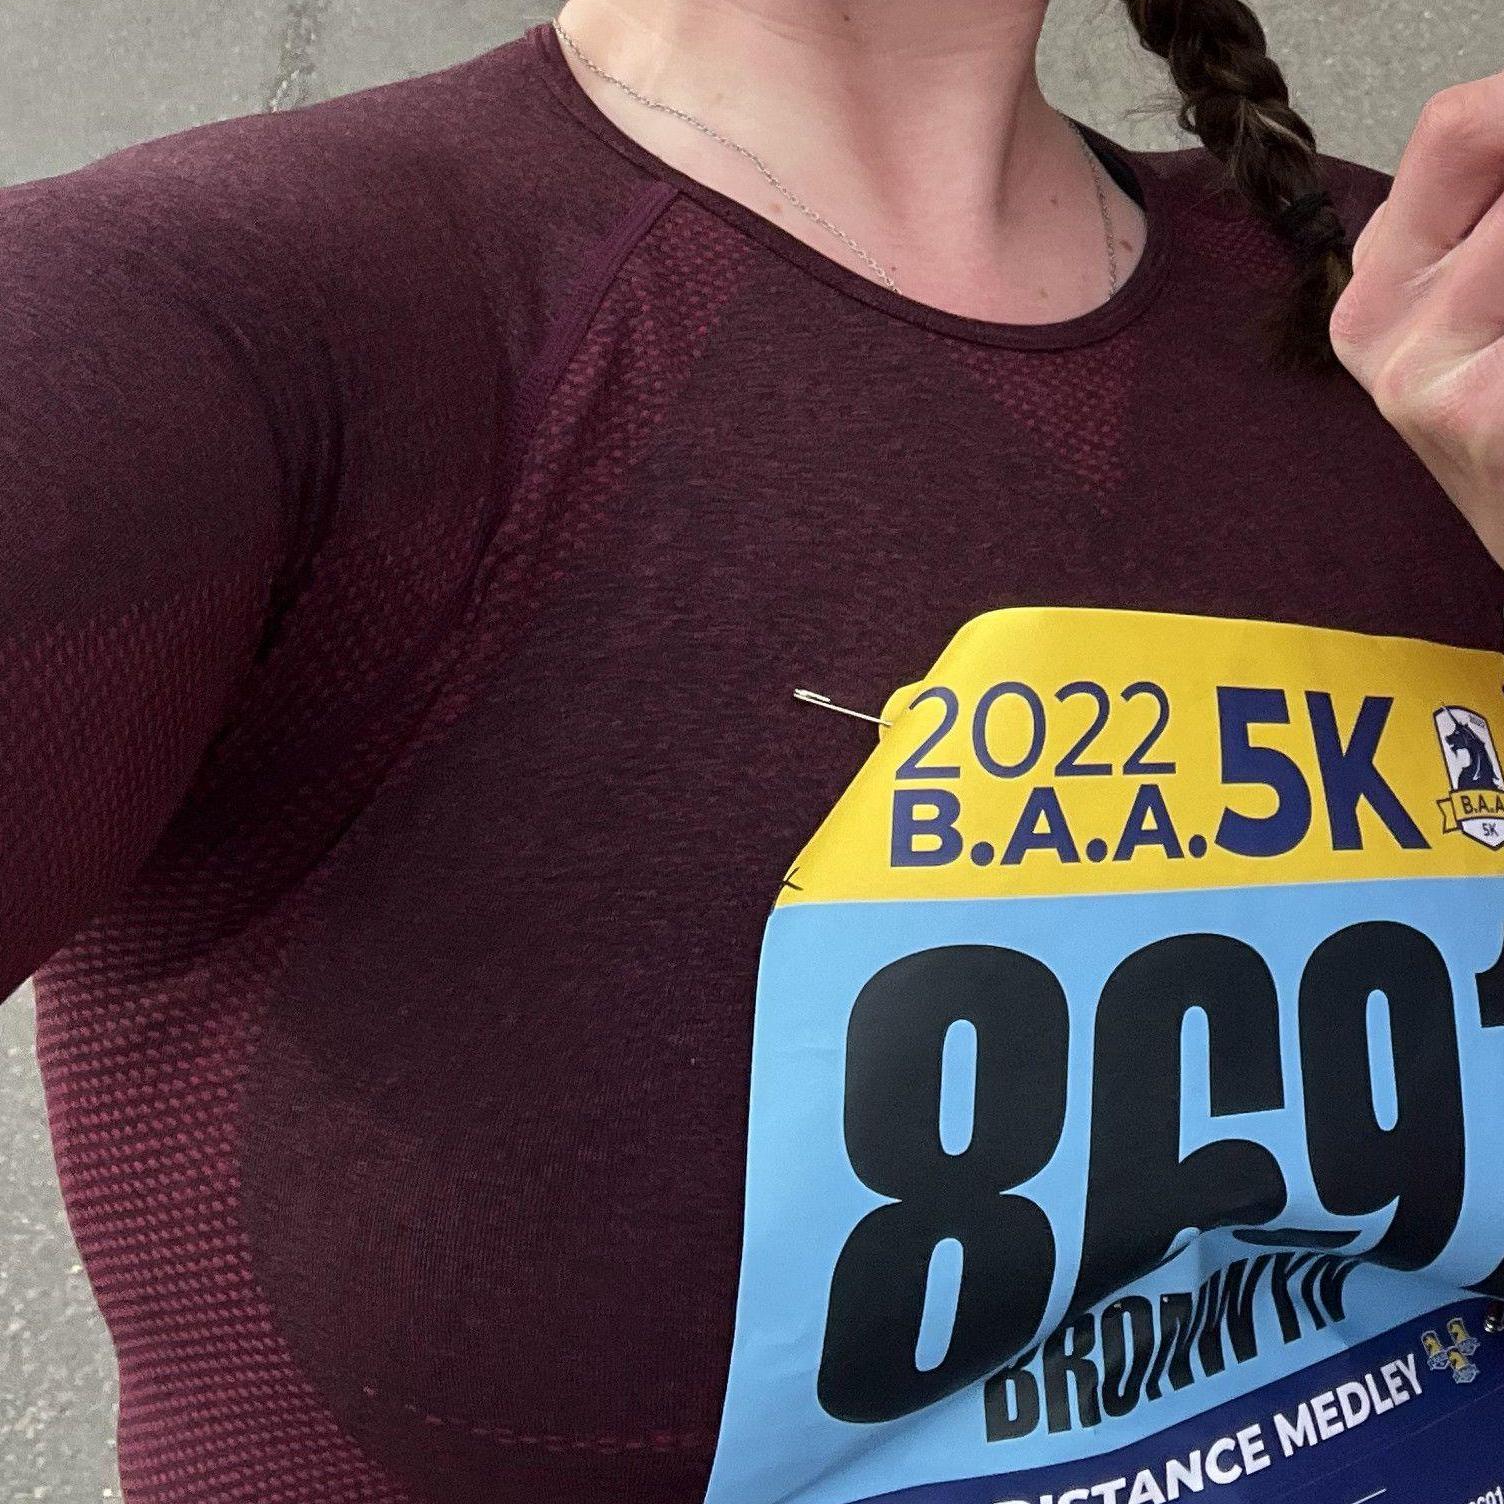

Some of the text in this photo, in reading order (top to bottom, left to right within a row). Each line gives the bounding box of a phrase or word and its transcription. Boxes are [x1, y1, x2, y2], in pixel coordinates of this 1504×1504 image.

[889, 686, 1431, 867] B.A.A. 5K
[890, 680, 1178, 780] 2022
[1481, 821, 1500, 837] 5K
[985, 1251, 1357, 1443] BRONWYN
[993, 1353, 1423, 1504] TANCE MEDLEY
